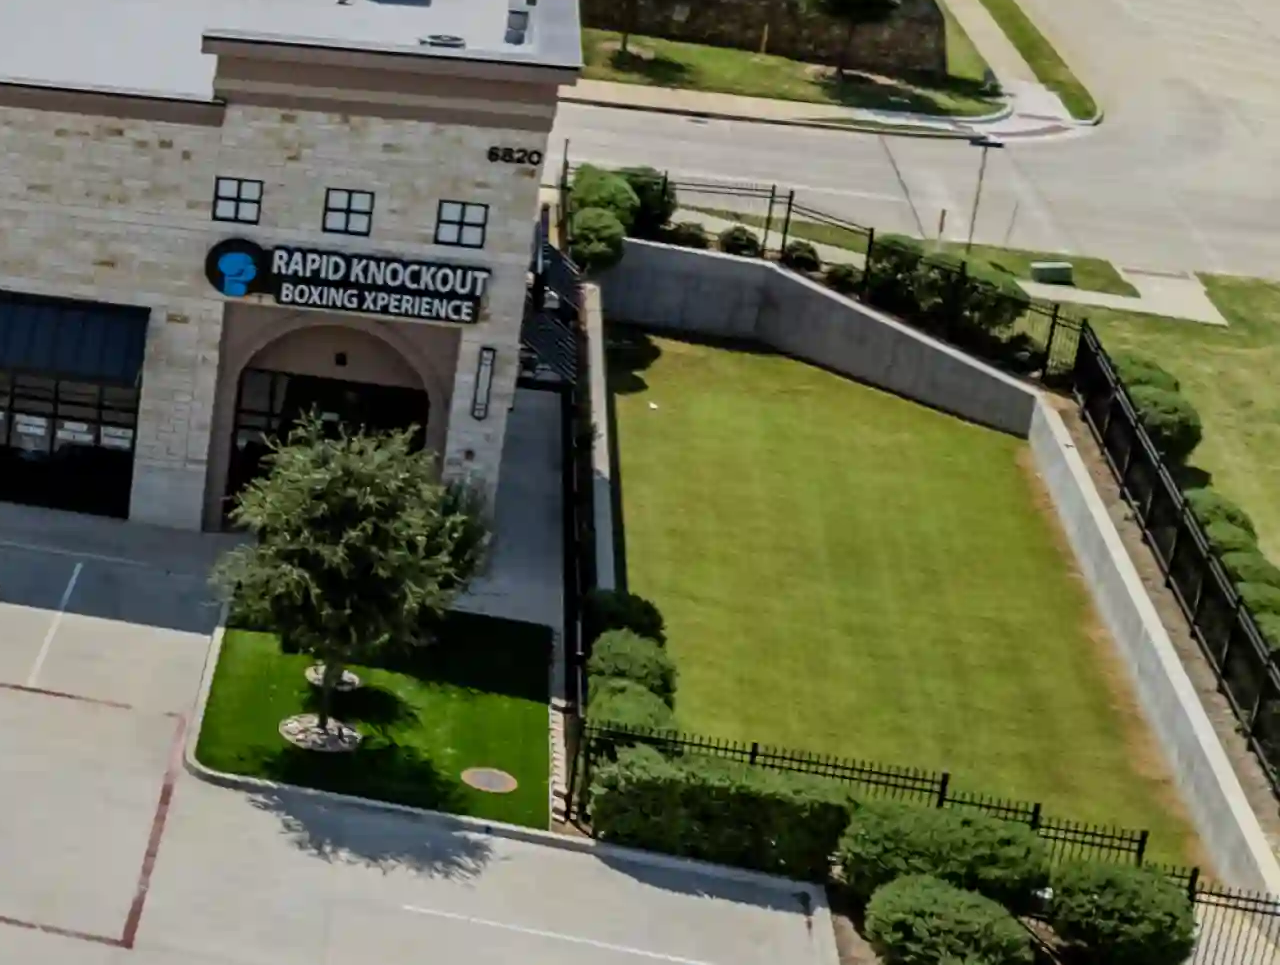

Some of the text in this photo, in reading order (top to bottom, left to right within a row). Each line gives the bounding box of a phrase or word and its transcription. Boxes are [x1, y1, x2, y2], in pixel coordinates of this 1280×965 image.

[486, 145, 544, 167] 6820
[271, 248, 491, 298] RAPID KNOCKOUT
[279, 283, 474, 323] BOXING XPERIENCE
